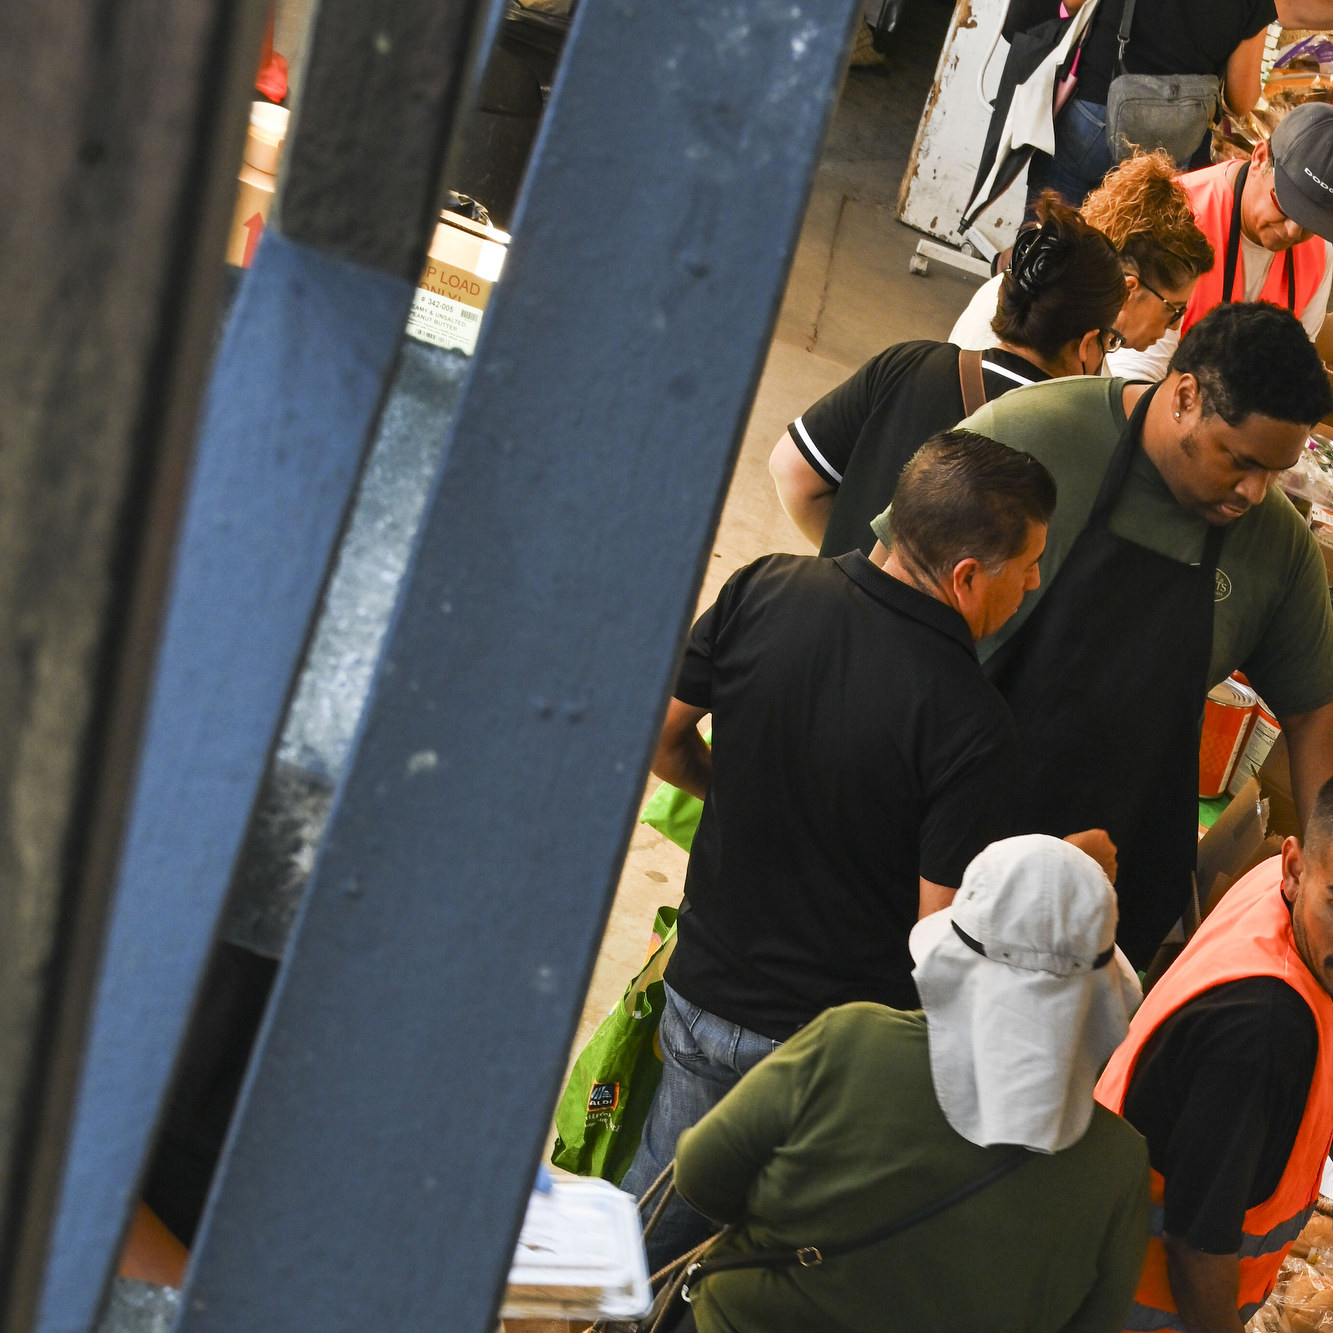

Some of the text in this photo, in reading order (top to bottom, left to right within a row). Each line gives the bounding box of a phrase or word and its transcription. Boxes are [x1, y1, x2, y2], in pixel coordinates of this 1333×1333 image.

[440, 271, 480, 296] LOAD
[434, 319, 457, 331] BUTTER
[435, 311, 466, 327] UNSALTED
